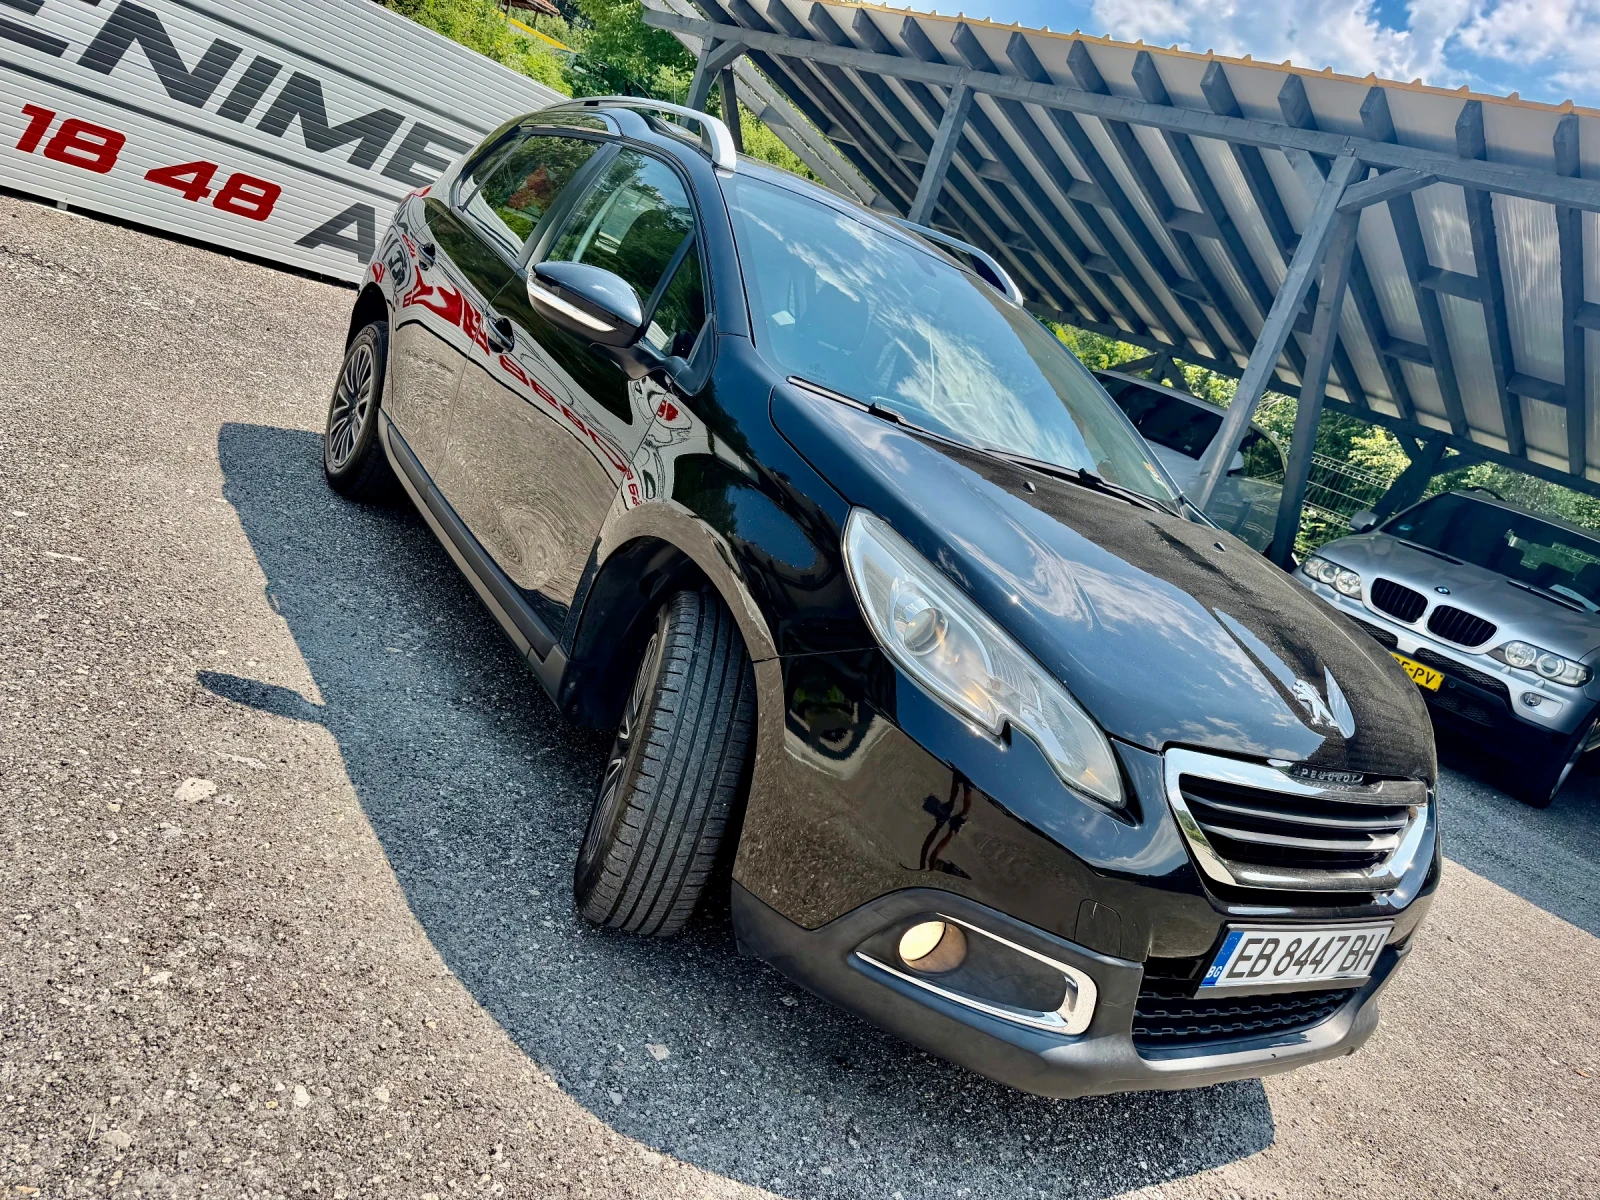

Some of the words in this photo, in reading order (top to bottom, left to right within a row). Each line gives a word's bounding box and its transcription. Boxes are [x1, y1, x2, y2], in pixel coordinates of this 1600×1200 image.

[16, 104, 126, 174] 18
[144, 161, 282, 222] 48
[1205, 965, 1223, 978] BG
